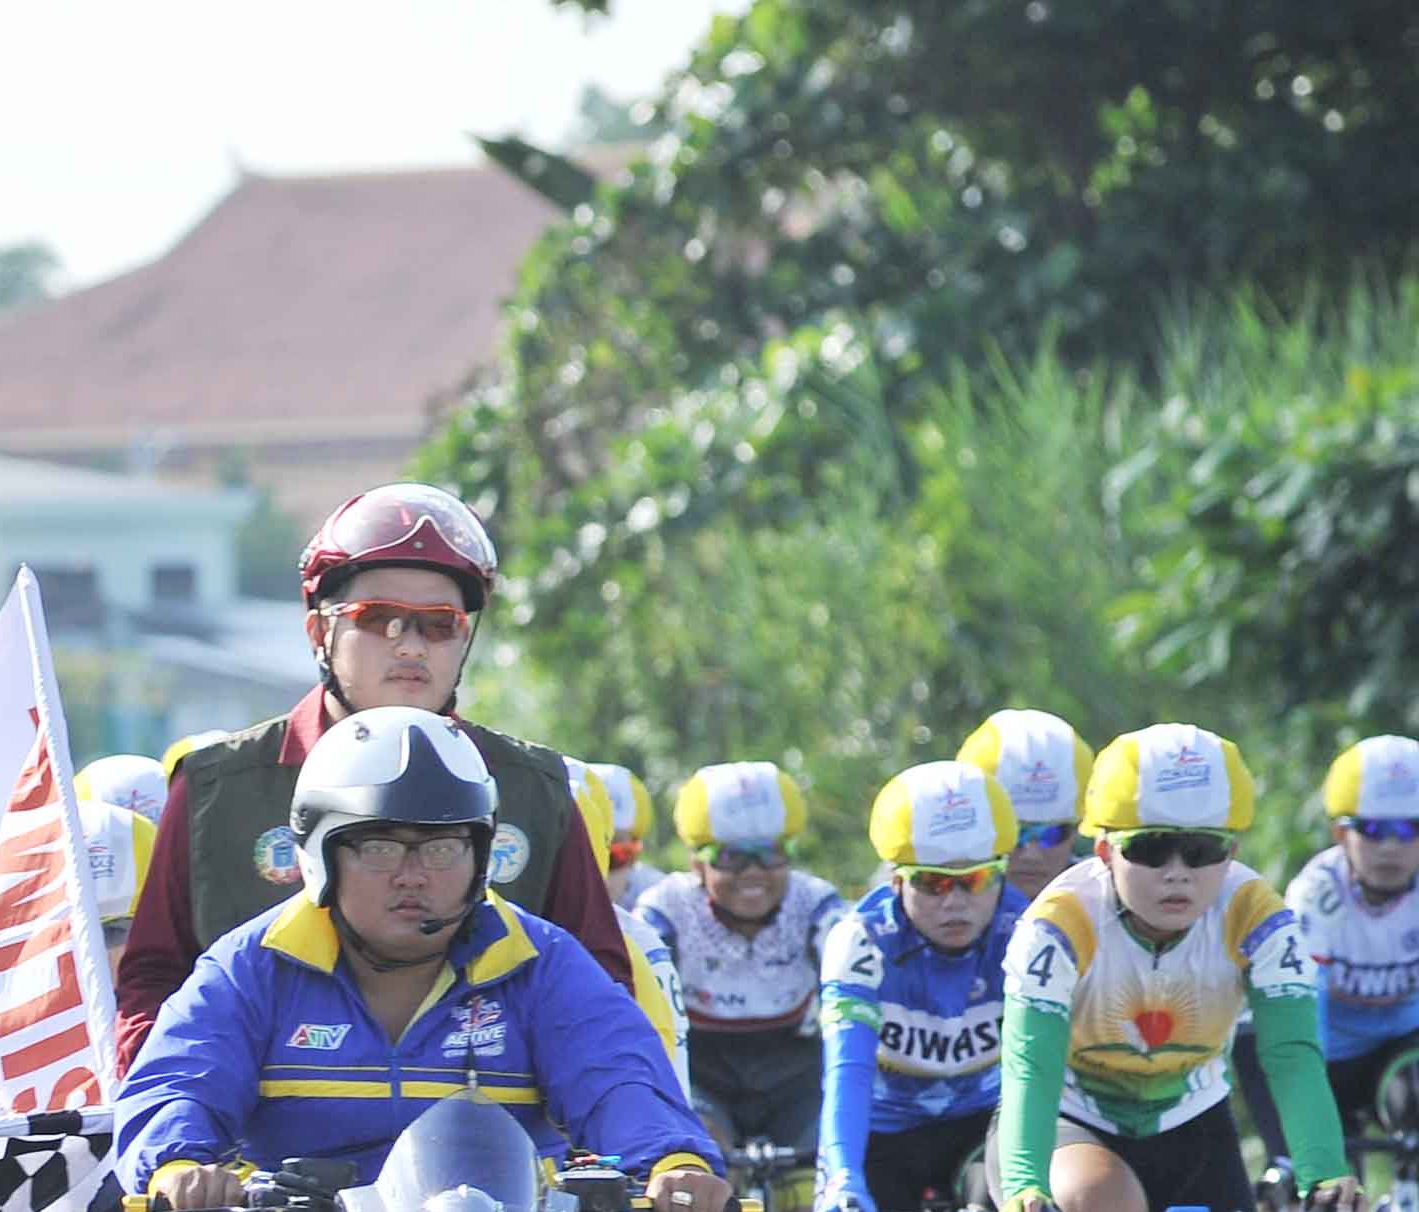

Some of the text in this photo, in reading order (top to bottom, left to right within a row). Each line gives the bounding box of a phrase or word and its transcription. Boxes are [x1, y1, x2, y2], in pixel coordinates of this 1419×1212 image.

[1026, 945, 1056, 986] 4
[1279, 935, 1302, 975] 4
[879, 1018, 1003, 1063] BIWAS
